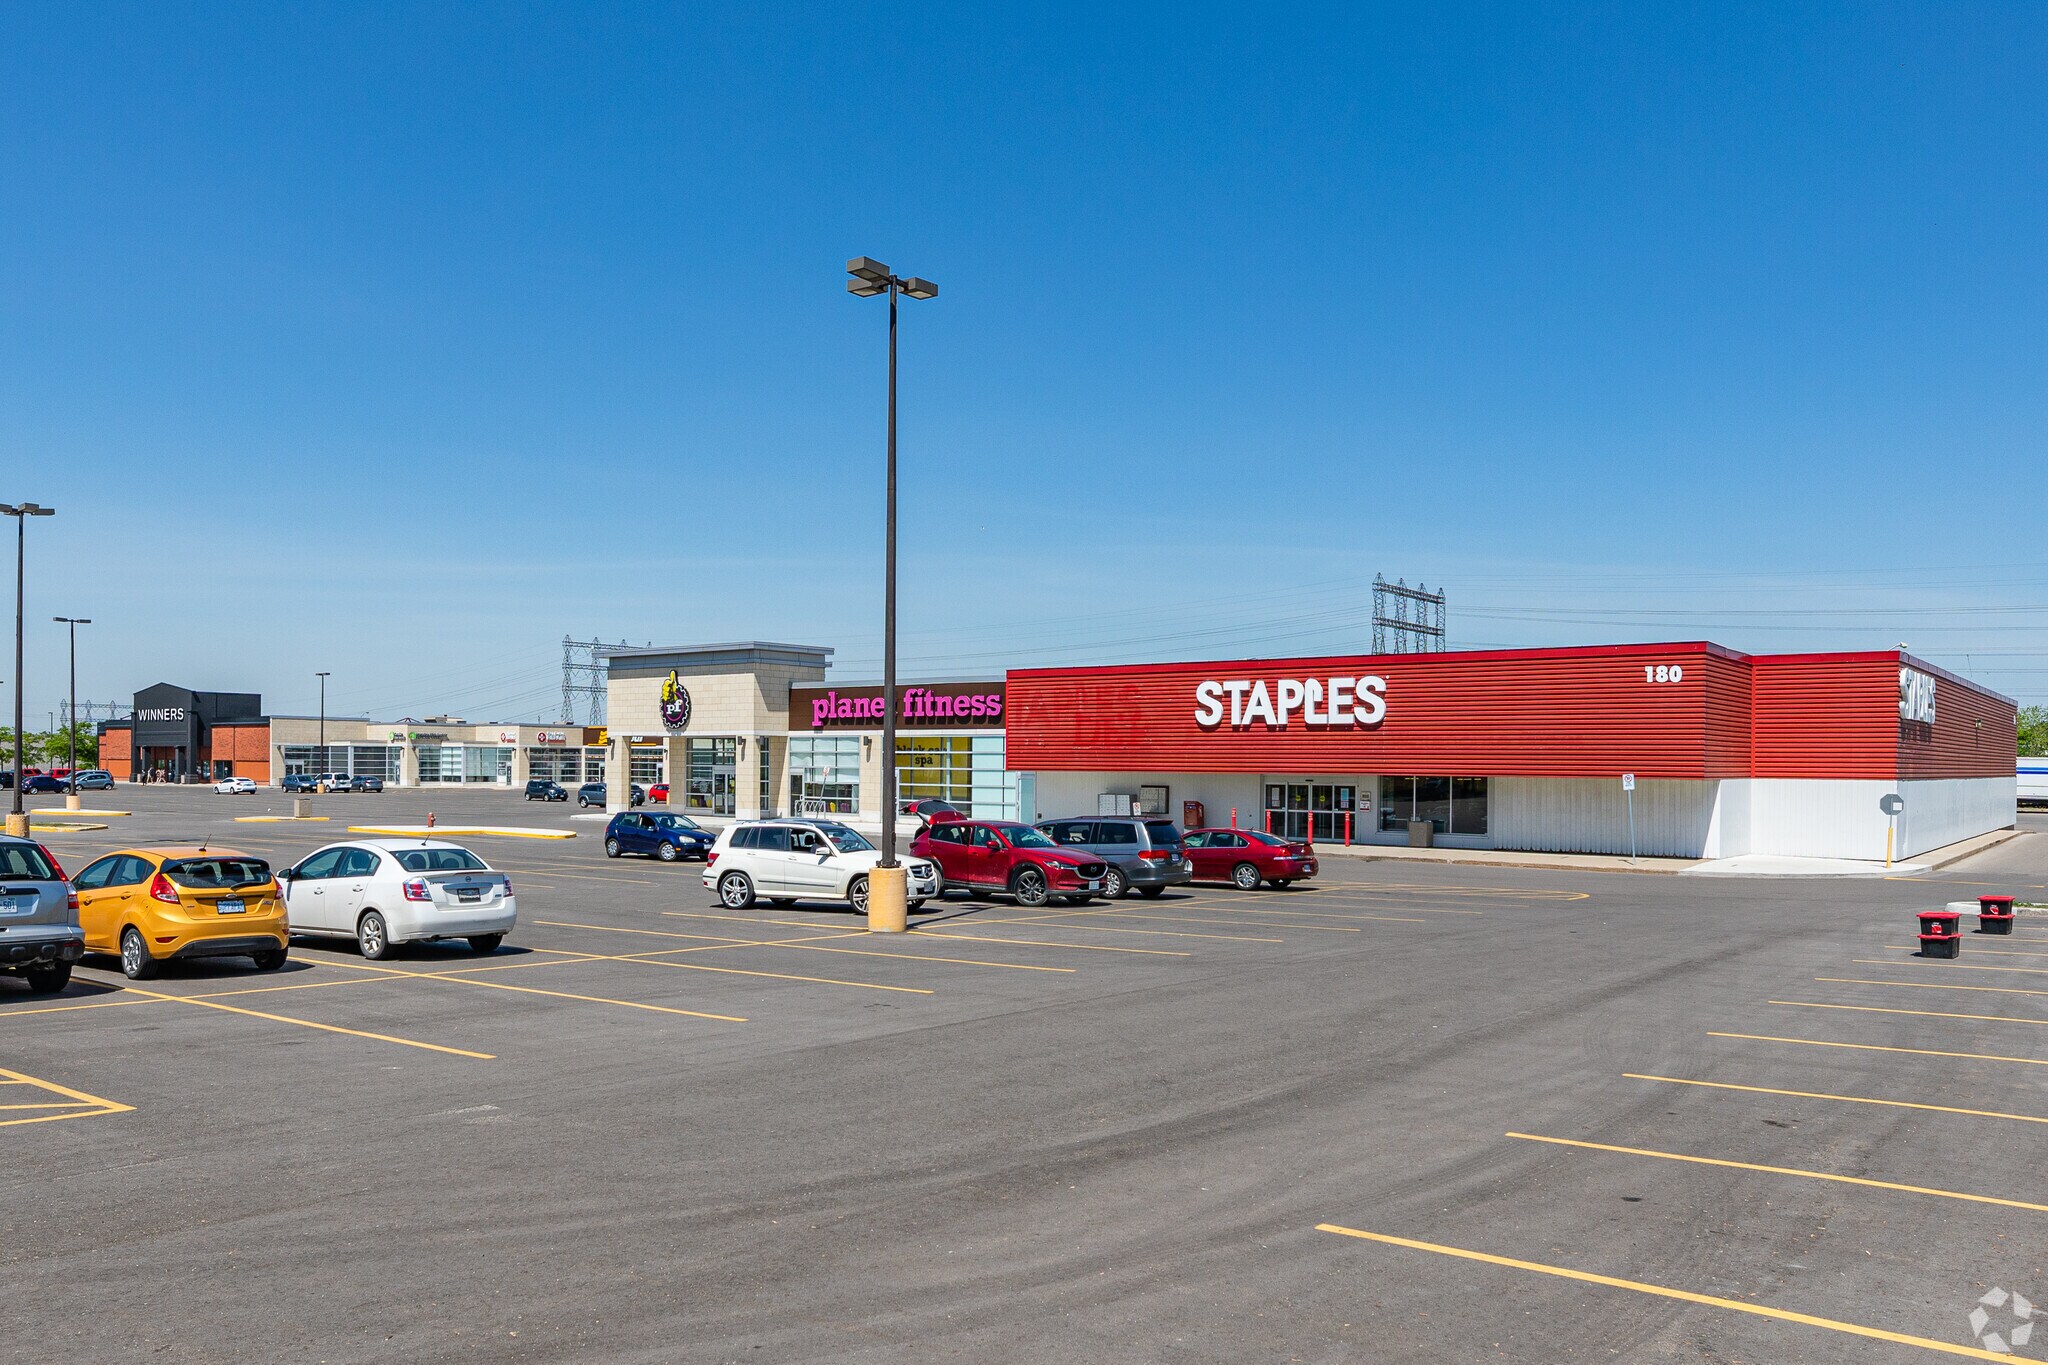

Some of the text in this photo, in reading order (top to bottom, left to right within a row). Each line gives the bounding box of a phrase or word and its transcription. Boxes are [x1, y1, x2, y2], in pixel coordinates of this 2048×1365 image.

[1644, 665, 1683, 683] 180
[666, 699, 683, 714] pf
[812, 688, 1002, 727] plane fitness
[1194, 675, 1387, 726] STAPLES
[138, 707, 184, 721] WINNERS
[915, 756, 933, 767] spa
